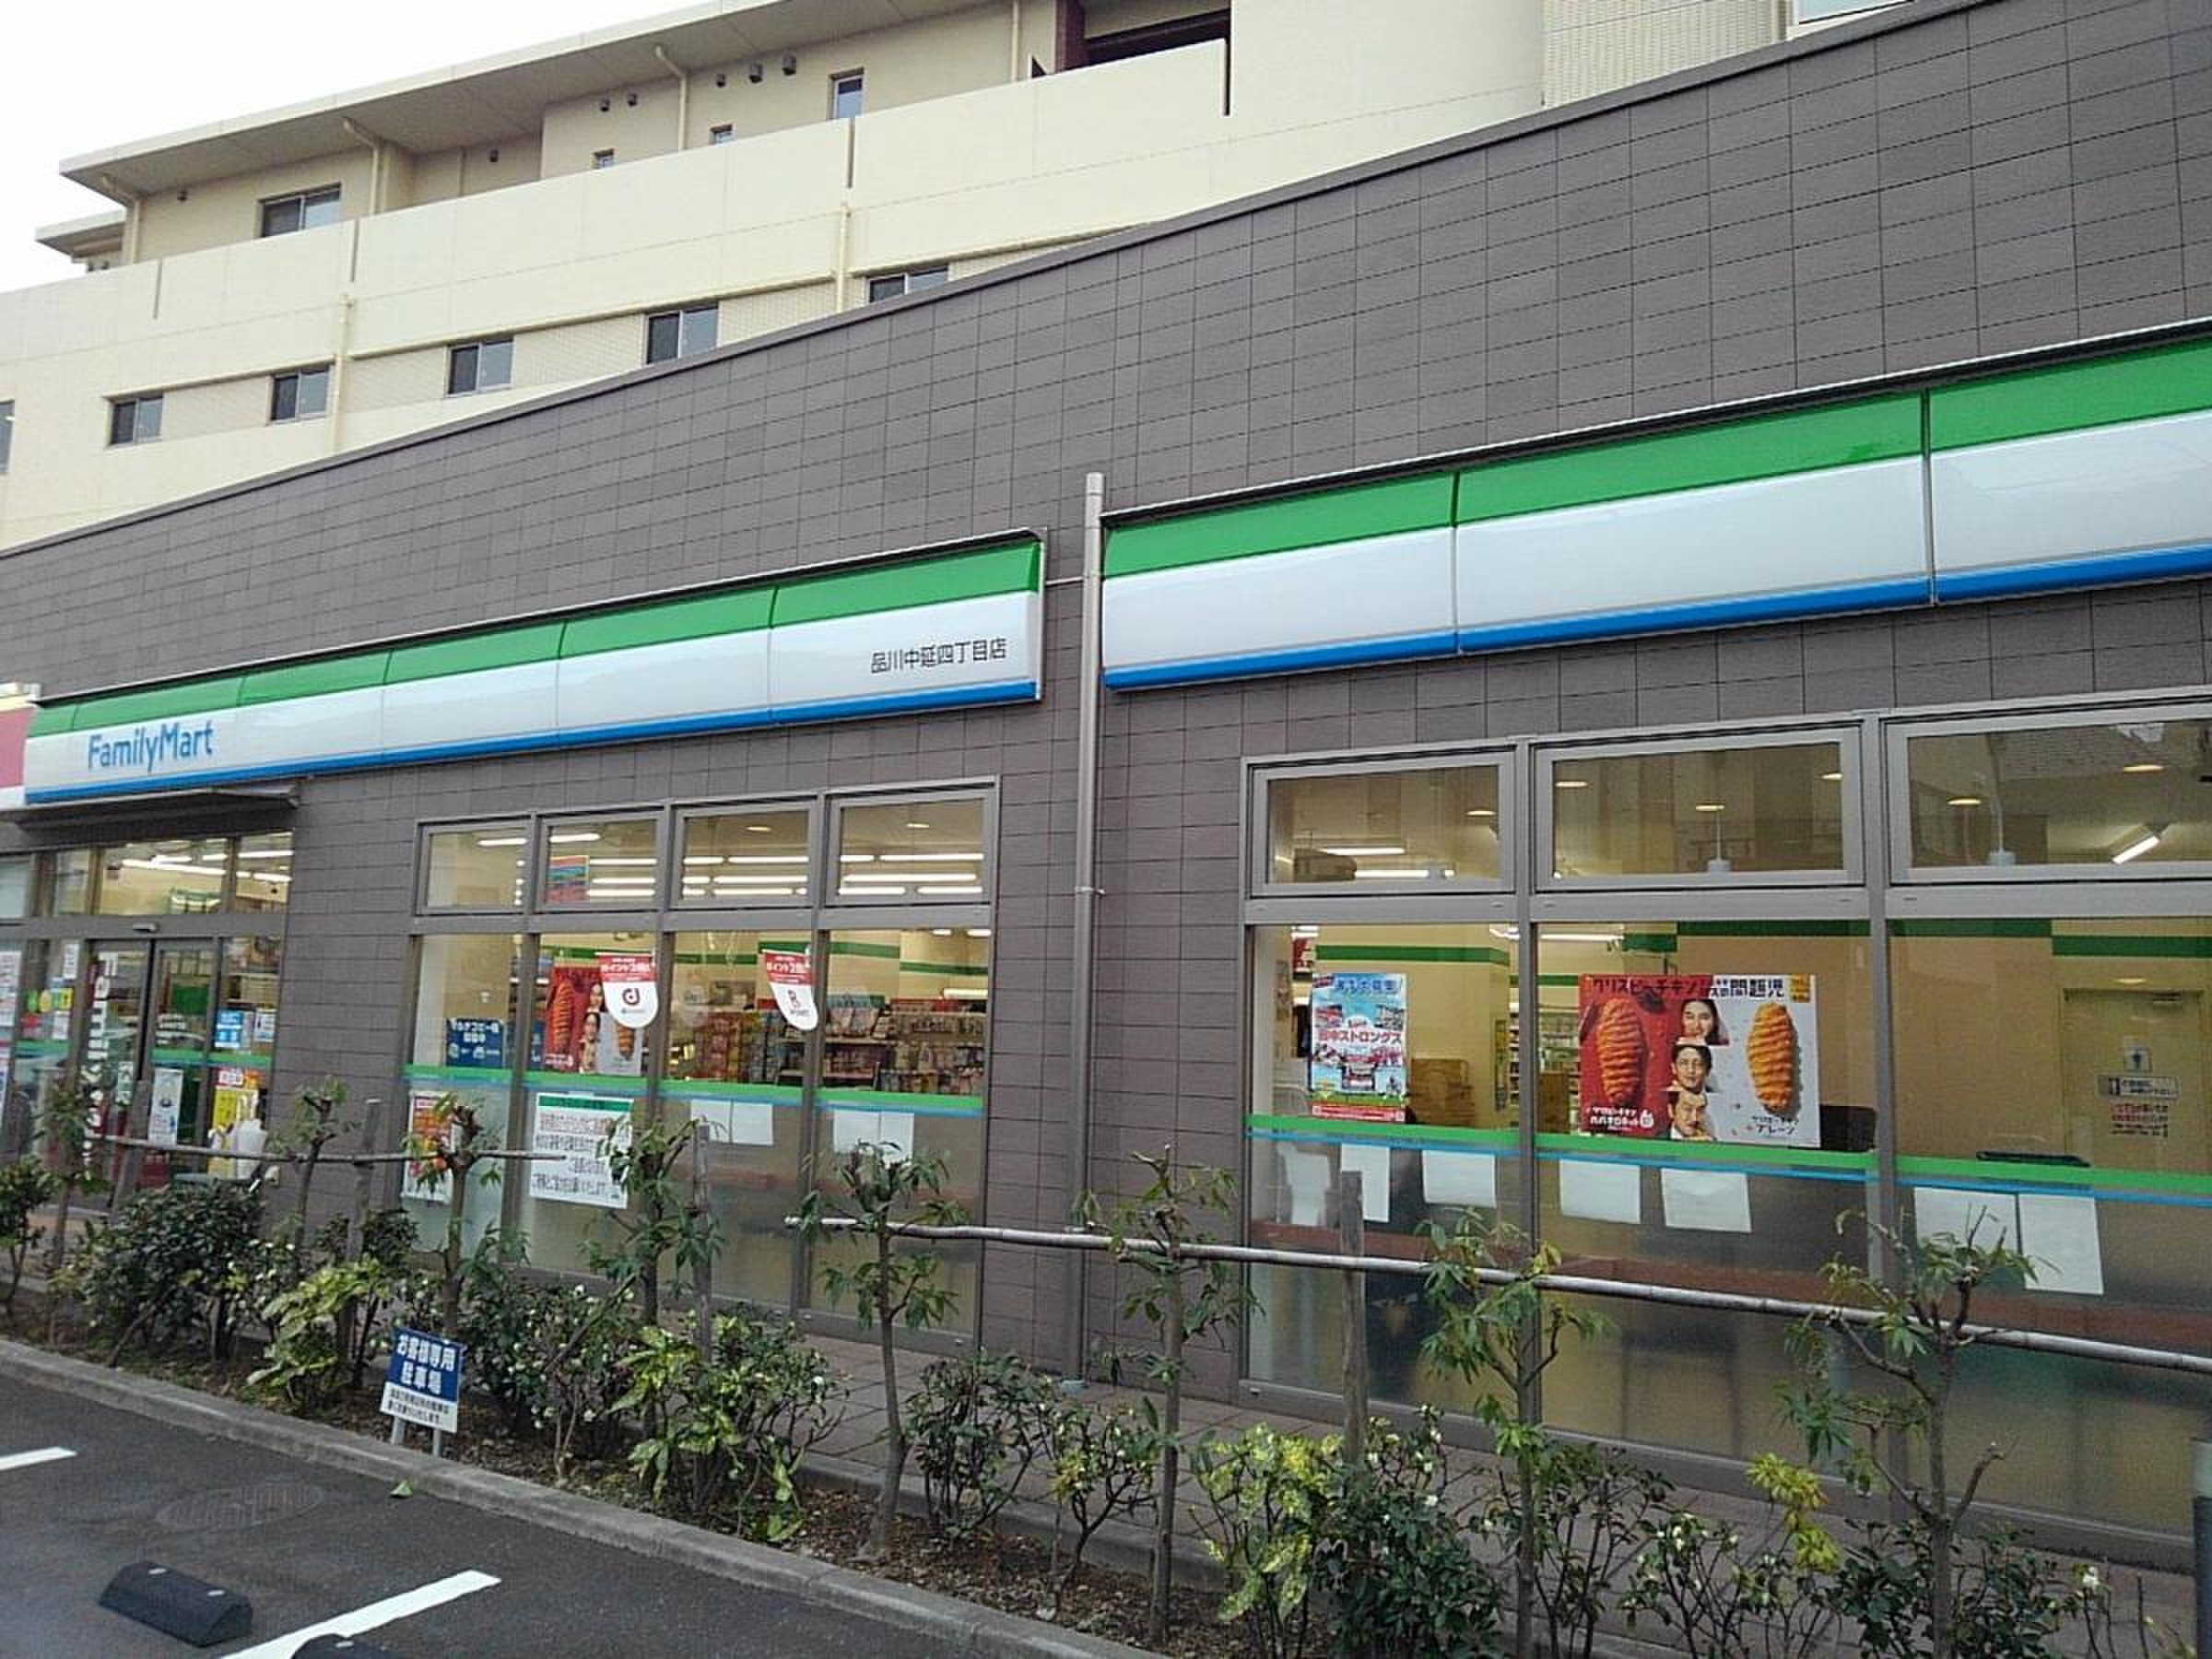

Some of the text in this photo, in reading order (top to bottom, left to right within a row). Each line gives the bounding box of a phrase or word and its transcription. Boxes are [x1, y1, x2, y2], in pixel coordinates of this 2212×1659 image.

[871, 638, 1006, 674] 品川中延四丁目店
[88, 720, 214, 772] FamilyMart
